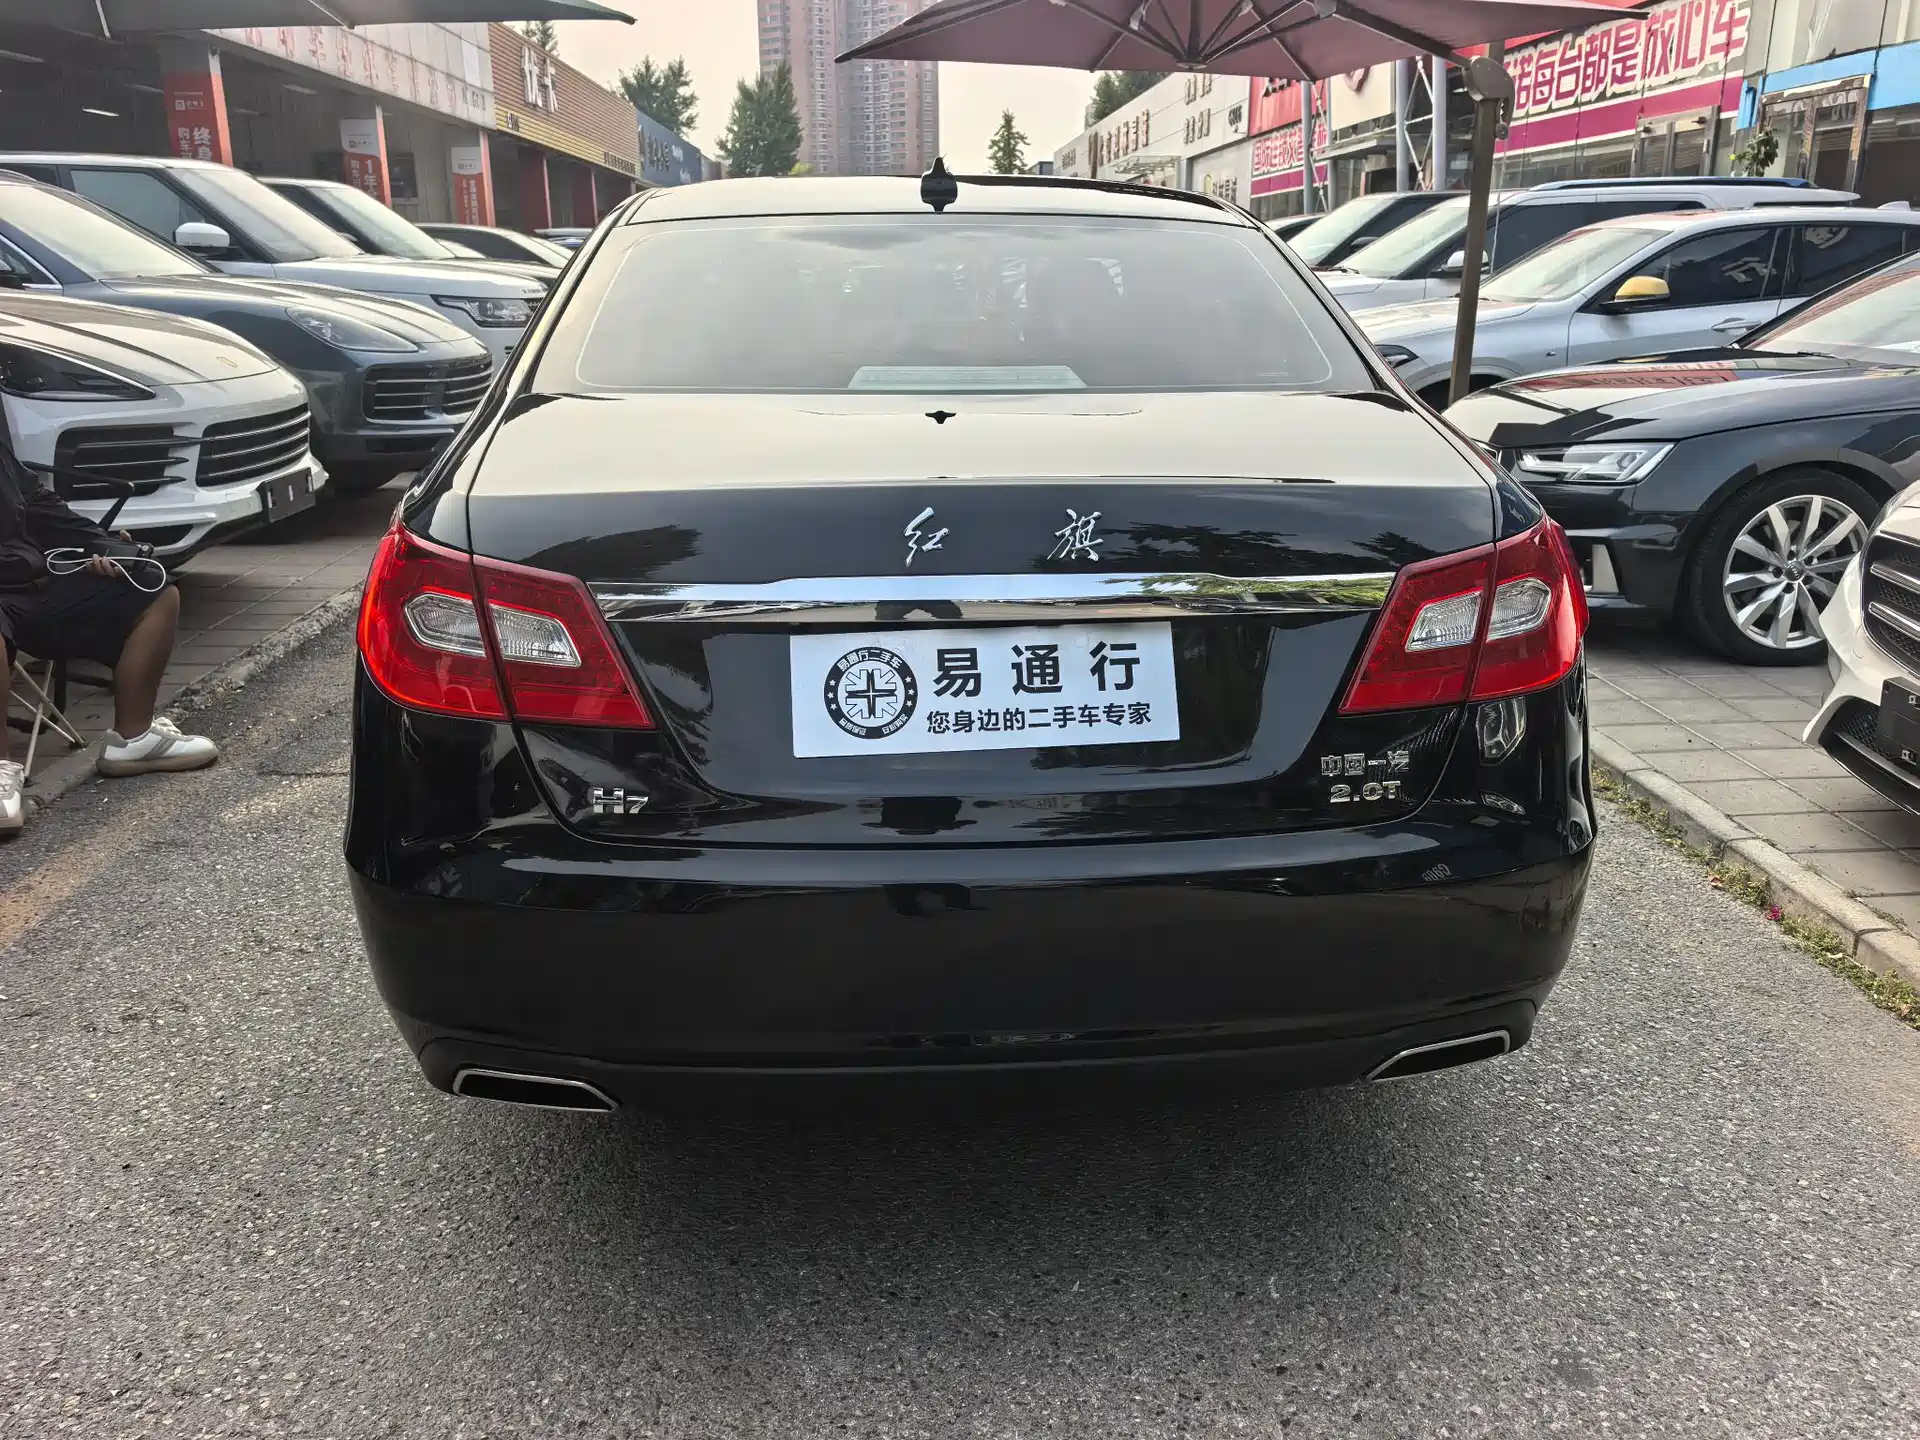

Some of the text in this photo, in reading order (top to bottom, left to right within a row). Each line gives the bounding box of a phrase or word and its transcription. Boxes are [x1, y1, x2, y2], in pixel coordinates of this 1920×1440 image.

[904, 506, 1104, 568] 红旗
[837, 648, 903, 672] 易通行二手车
[932, 640, 1141, 699] 易通行
[926, 701, 1152, 735] 您身边的二手车专家
[1320, 749, 1410, 777] 中国一汽
[592, 787, 649, 814] H7
[1329, 780, 1402, 804] 2.0T
